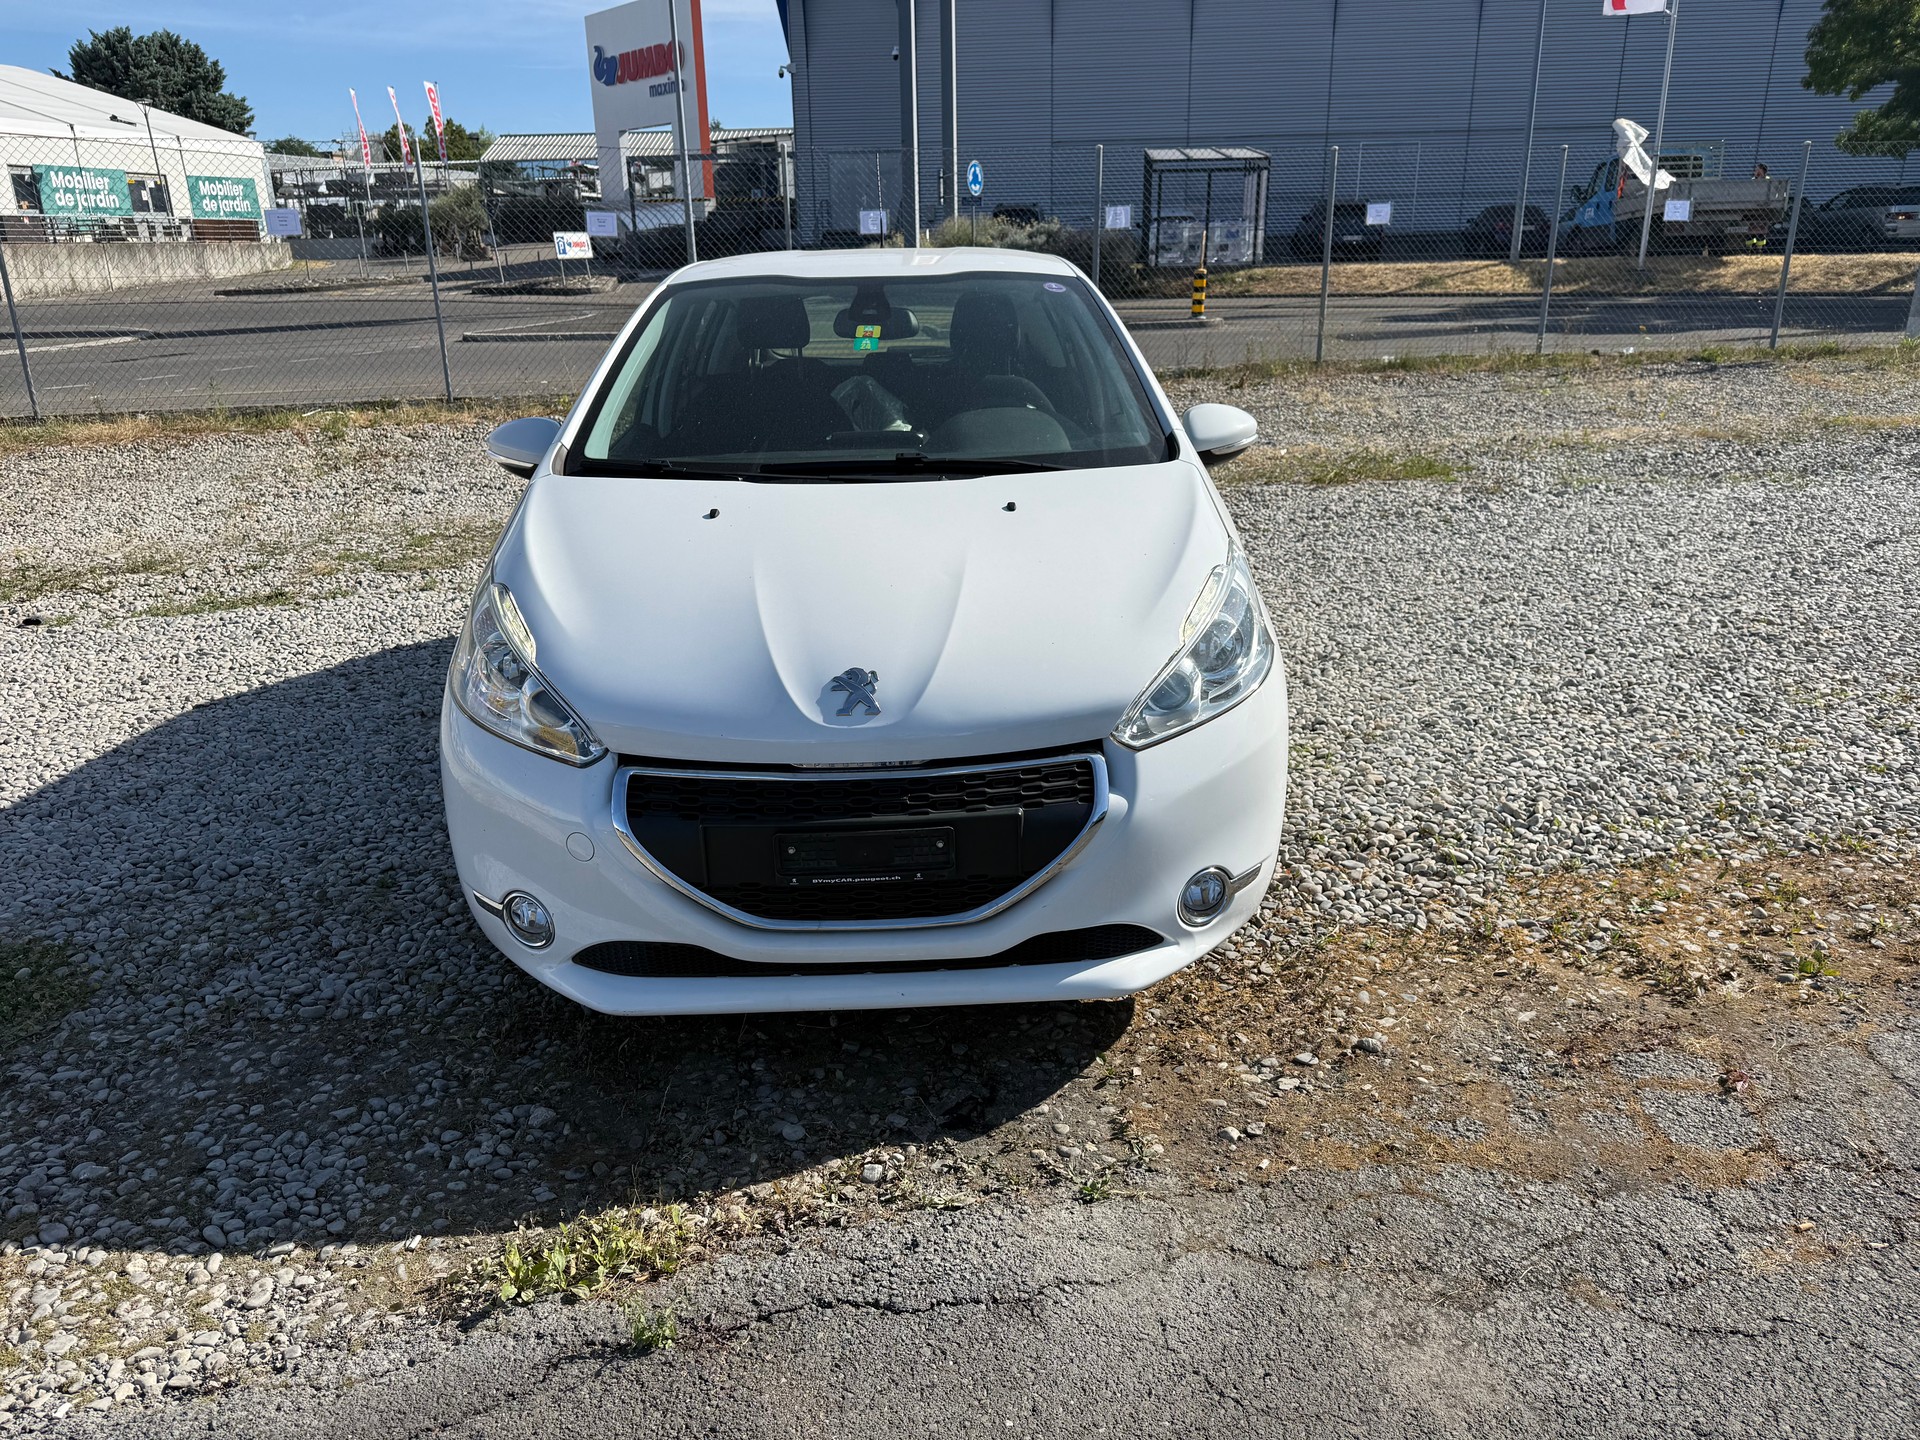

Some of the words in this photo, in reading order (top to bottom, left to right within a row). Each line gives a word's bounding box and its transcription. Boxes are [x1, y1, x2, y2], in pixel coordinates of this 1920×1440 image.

[50, 170, 110, 190] Mobilier
[198, 179, 244, 196] Mobilier
[55, 188, 75, 207] de
[75, 188, 120, 212] jardin
[202, 196, 218, 212] de
[218, 196, 252, 216] jardin
